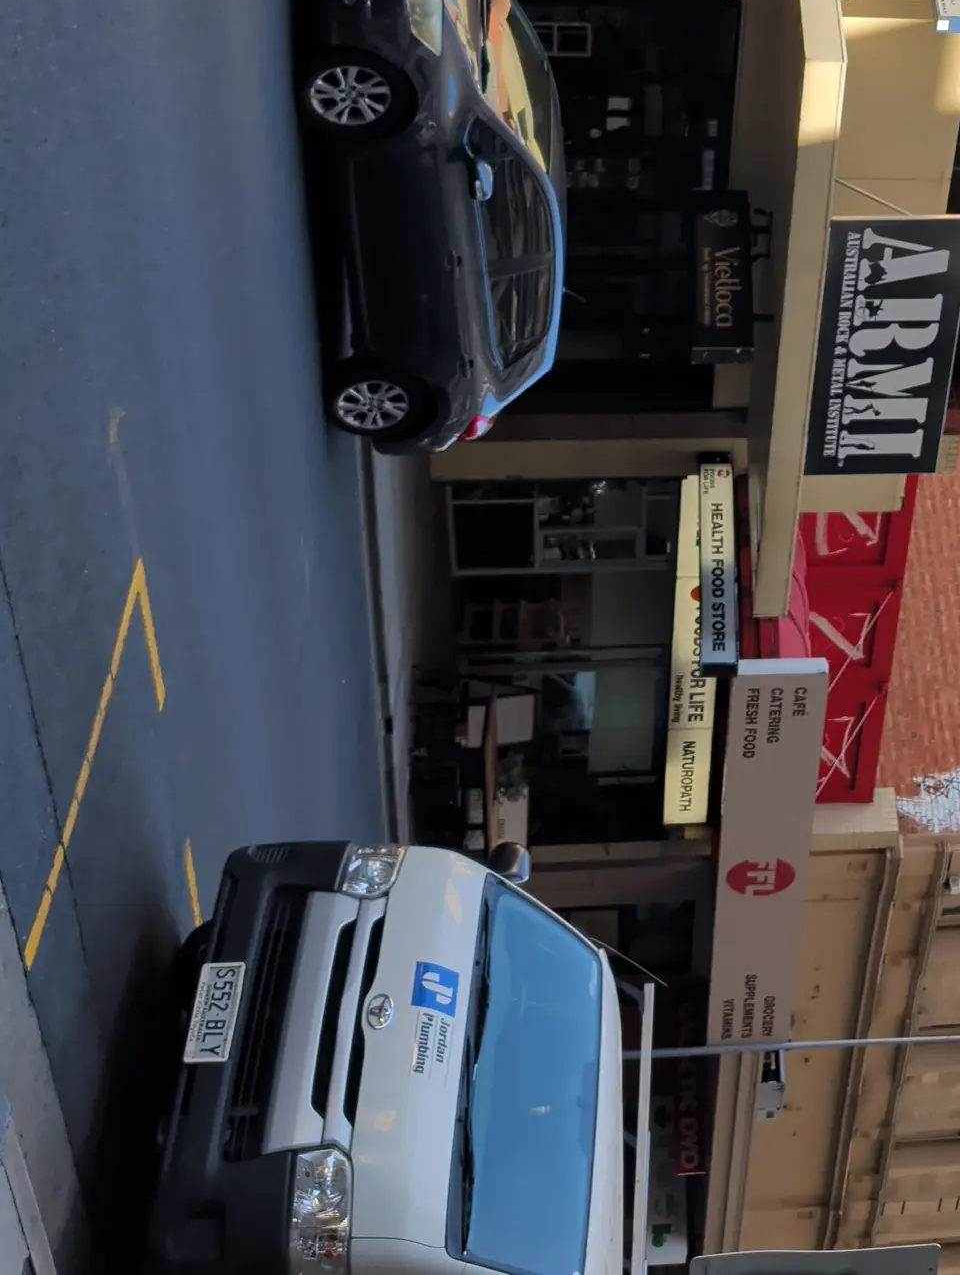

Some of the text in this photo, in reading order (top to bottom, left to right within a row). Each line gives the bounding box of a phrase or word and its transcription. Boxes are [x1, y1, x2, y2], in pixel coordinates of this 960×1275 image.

[823, 231, 862, 457] AUSTRALIAN ROCK & METAL INSTITUTE
[838, 228, 950, 459] ARMI
[711, 502, 726, 652] HEALTH FOOD STORE
[671, 675, 684, 723] healthy living
[687, 692, 706, 723] LIFE
[742, 688, 760, 759] FRESH FOOD
[766, 687, 784, 744] CATERING
[792, 687, 809, 717] CAFÉ
[678, 740, 697, 812] NATUROPATH
[721, 998, 735, 1040] VITAMINS
[741, 974, 758, 1039] SUPPLEMENTS
[761, 996, 776, 1037] GROCERY
[413, 1012, 436, 1074] Plumbing
[435, 1018, 451, 1064] Jordan
[679, 1116, 700, 1170] DVD
